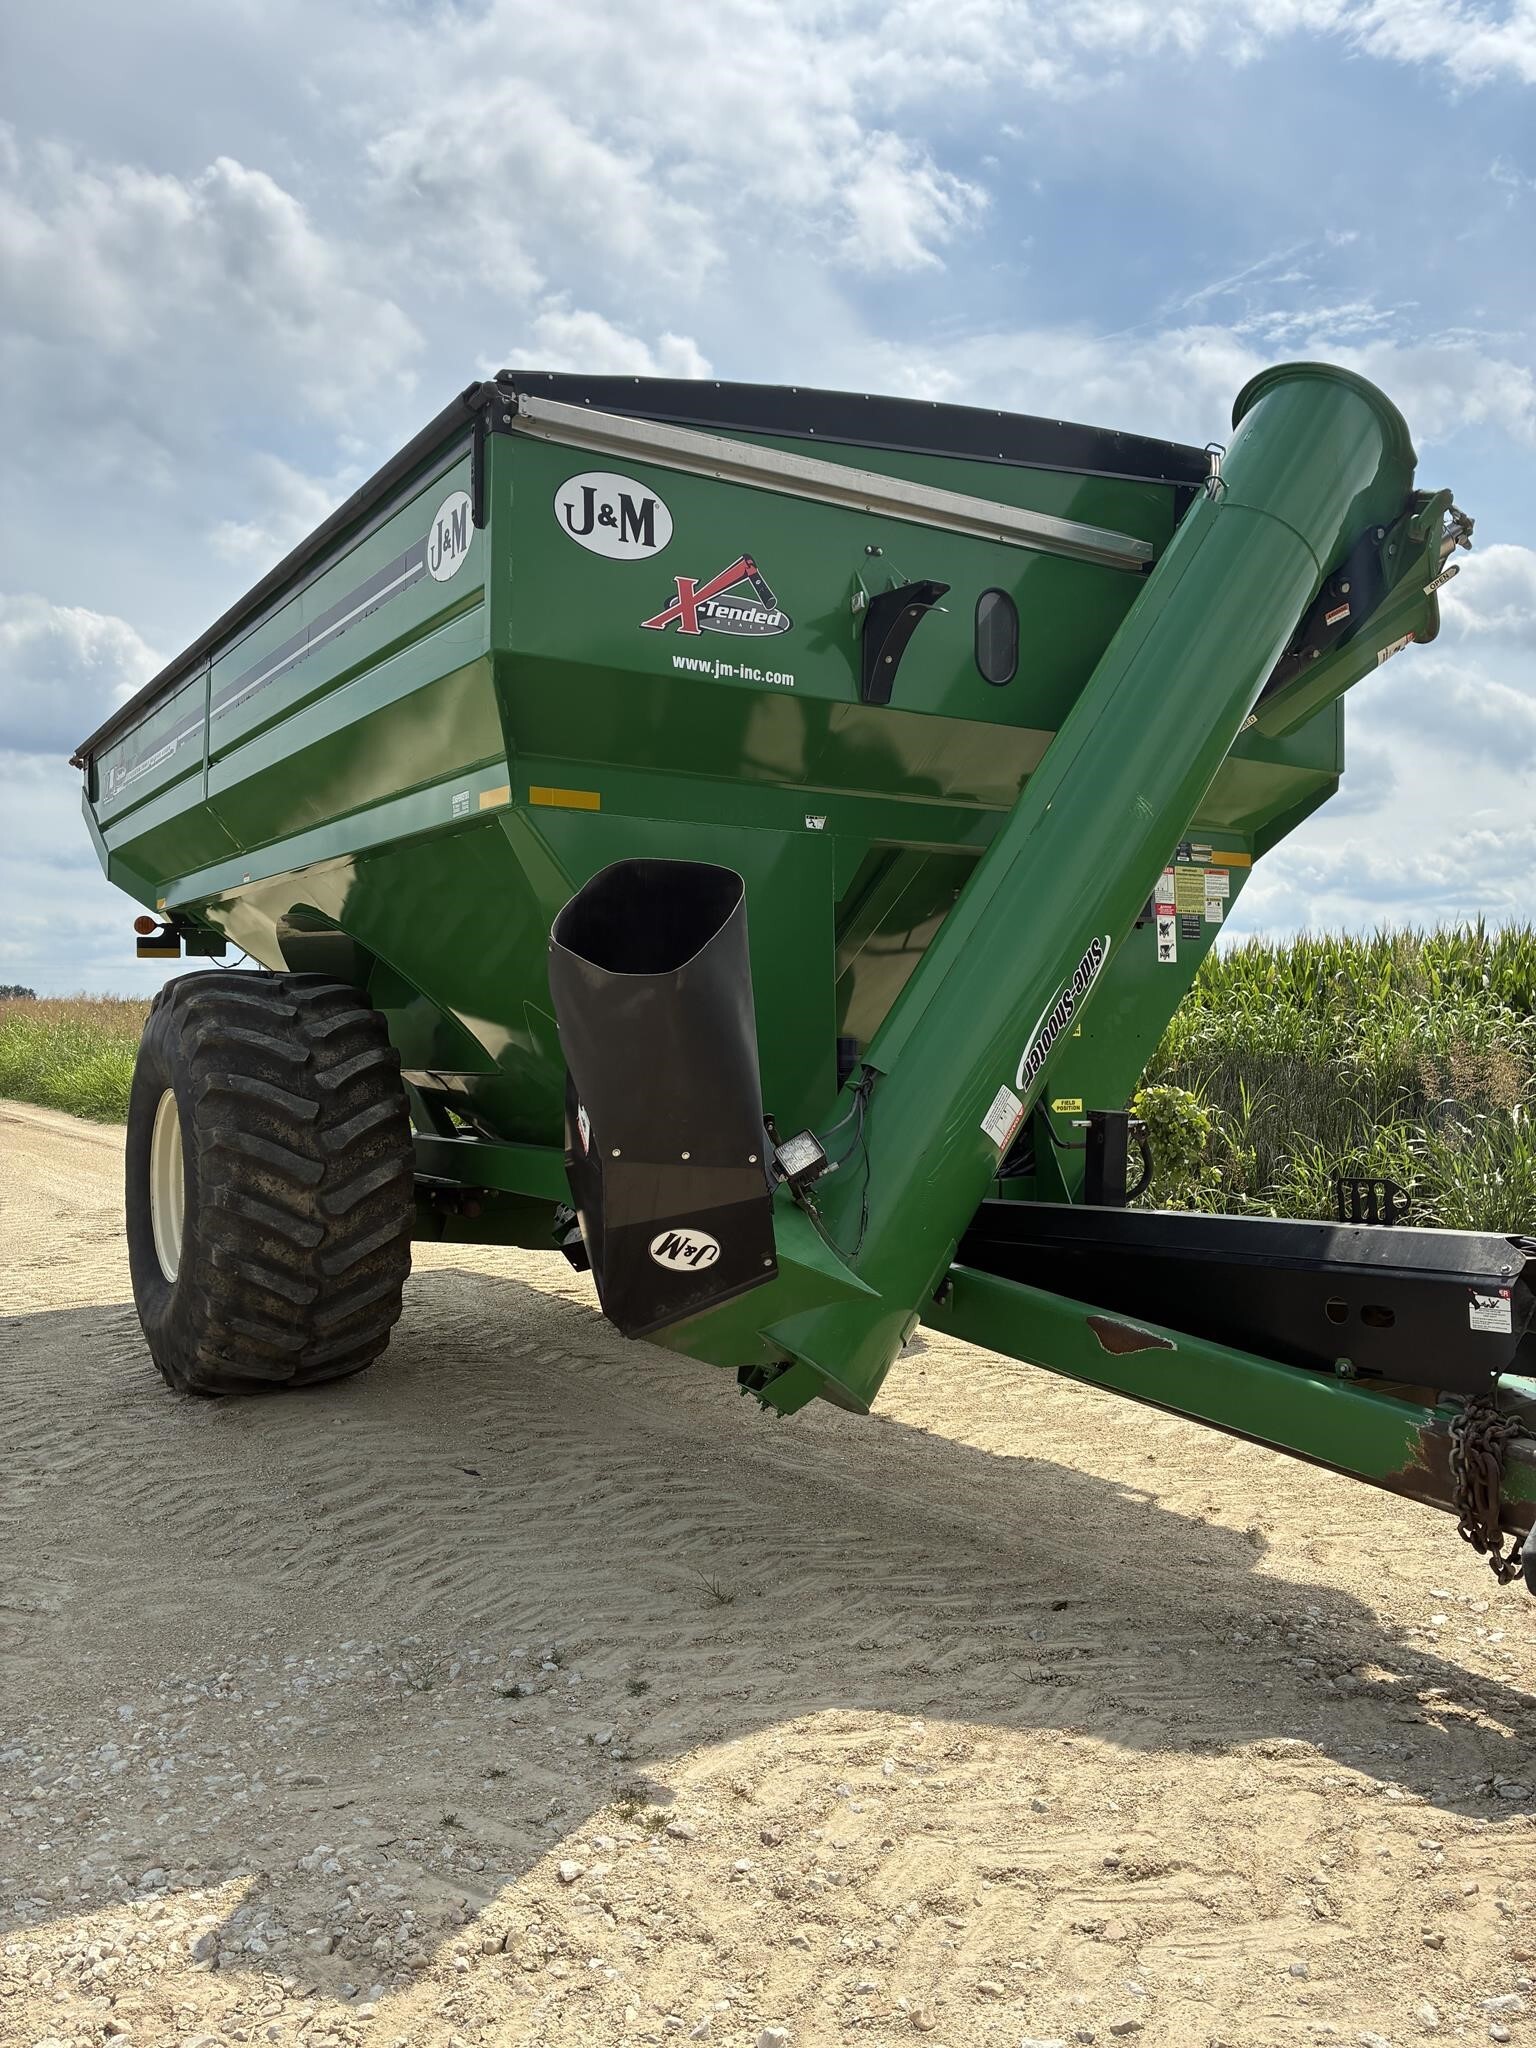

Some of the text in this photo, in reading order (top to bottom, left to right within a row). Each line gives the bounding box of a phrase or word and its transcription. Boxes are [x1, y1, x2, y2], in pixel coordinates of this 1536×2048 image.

[563, 486, 657, 548] J&M
[430, 501, 468, 572] J&M
[1429, 573, 1450, 590] OPEN
[672, 655, 795, 687] www.jm-inc.com
[654, 1232, 718, 1267] J&M
